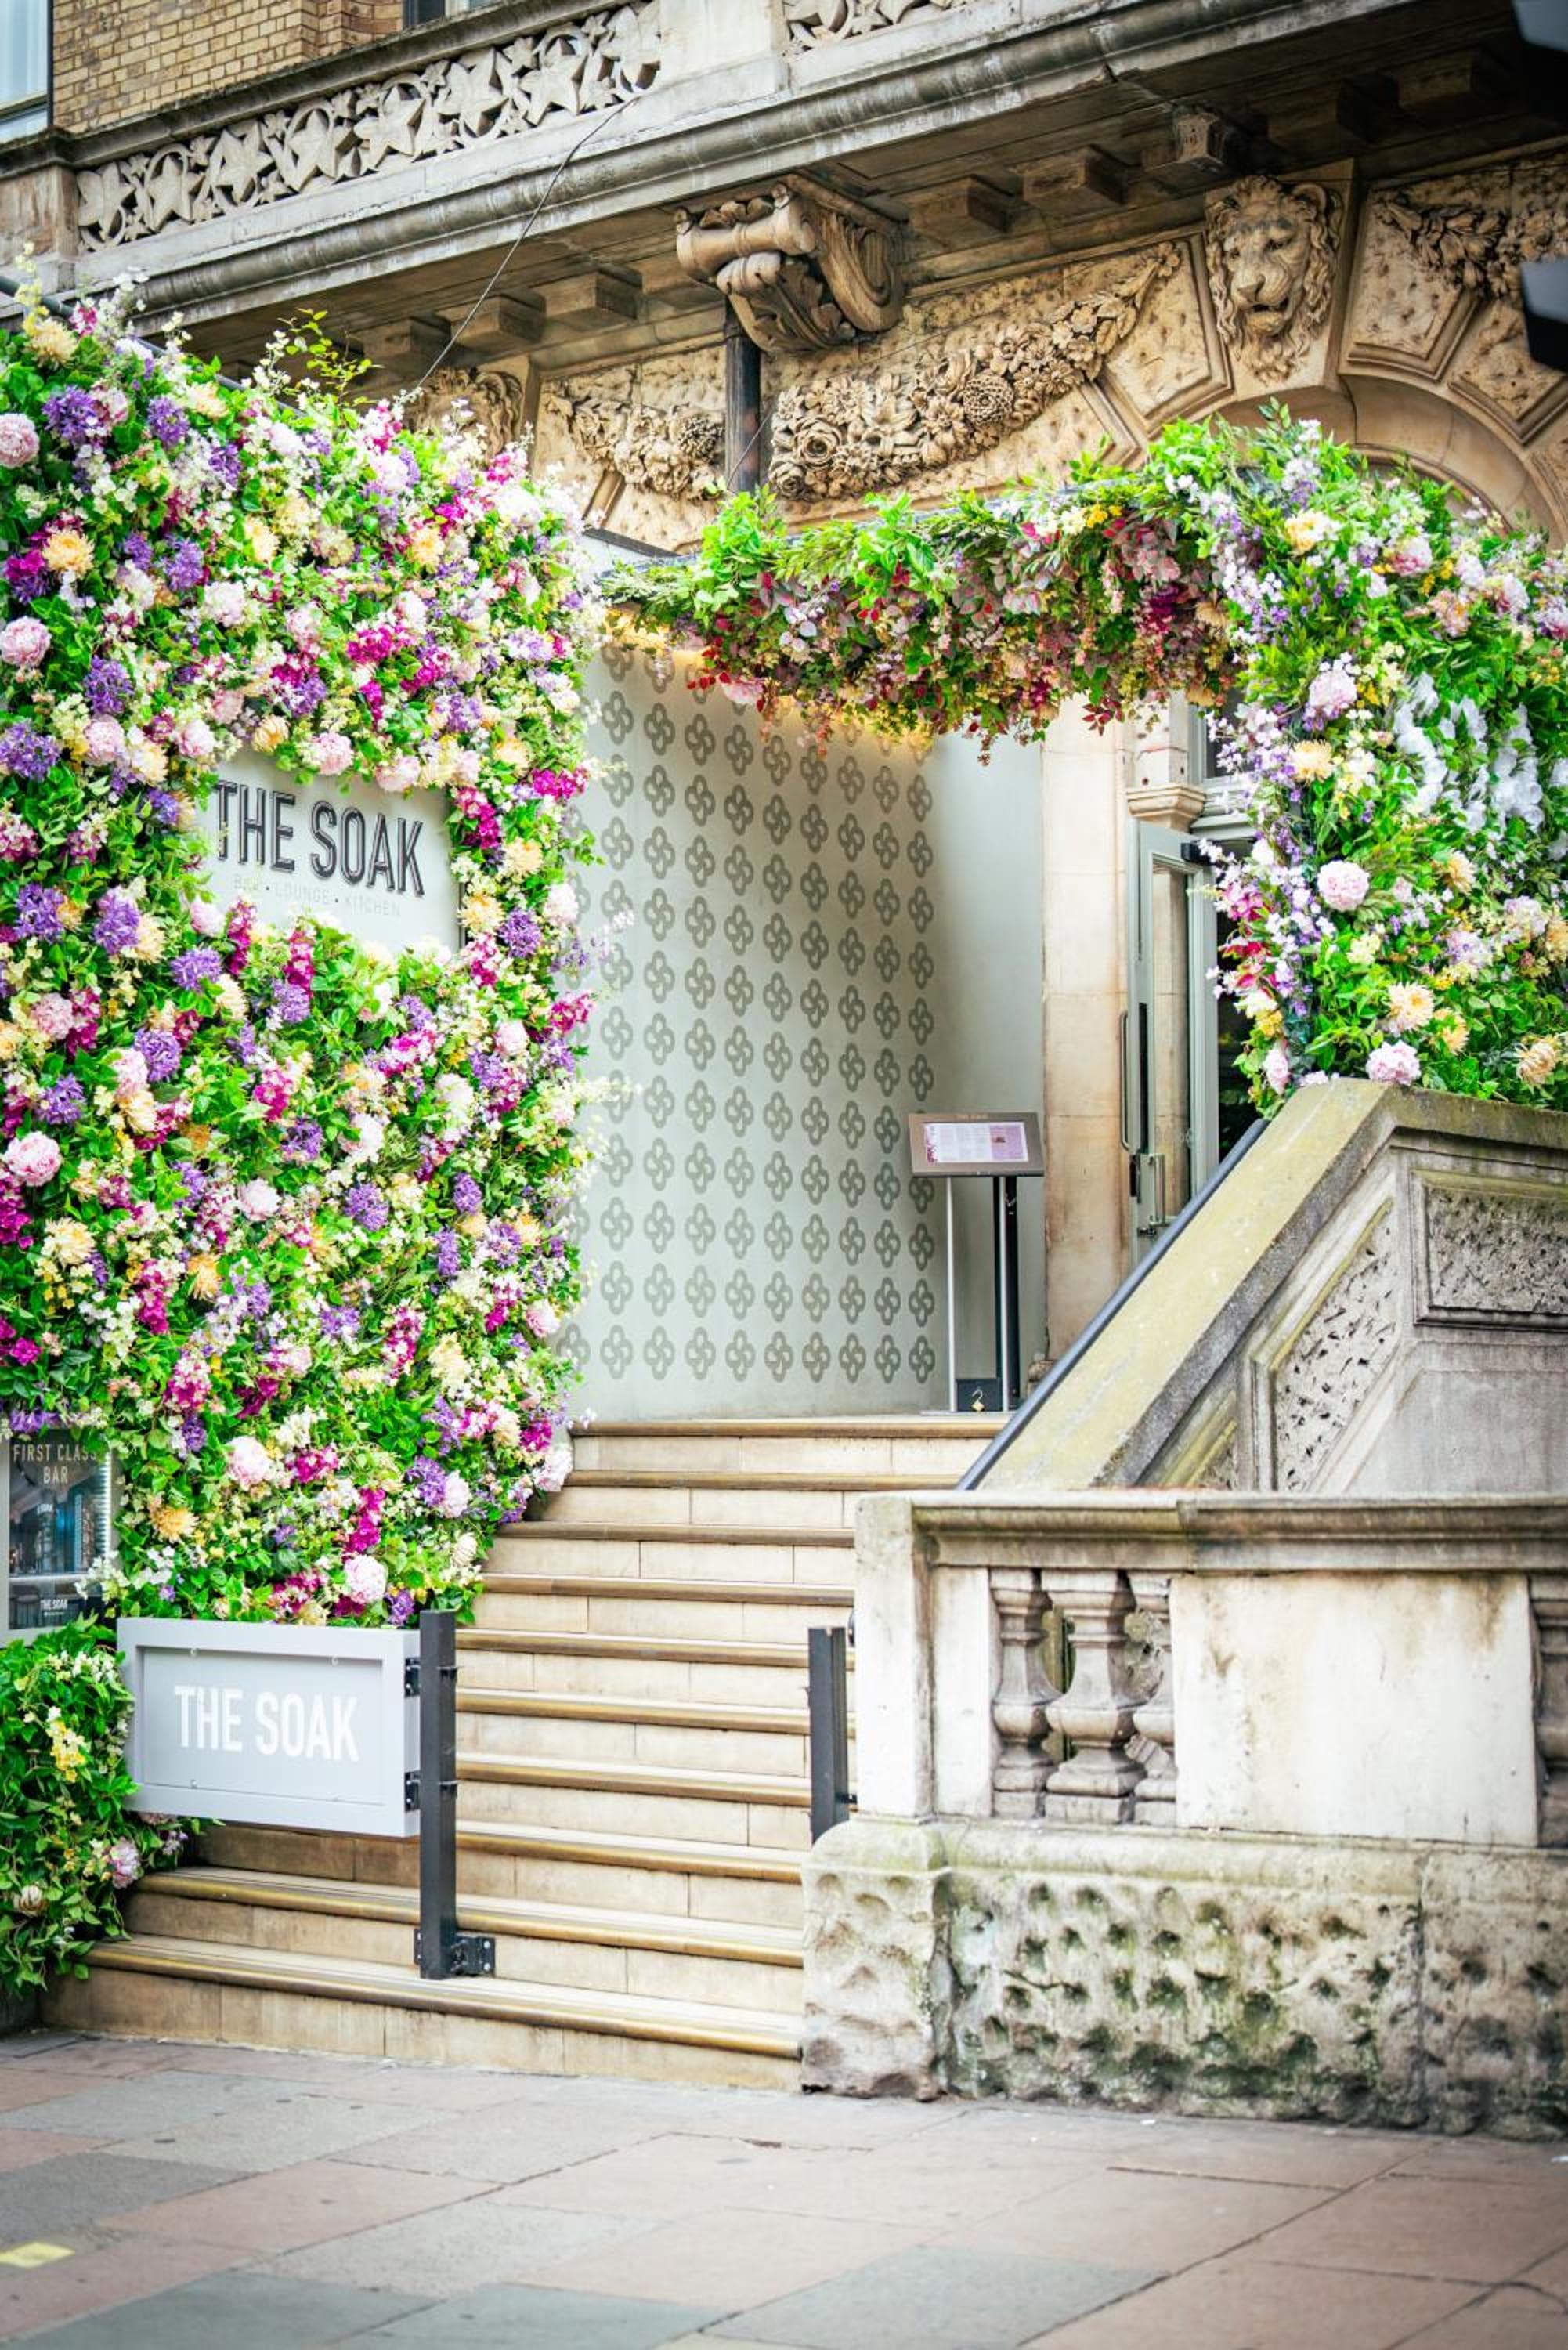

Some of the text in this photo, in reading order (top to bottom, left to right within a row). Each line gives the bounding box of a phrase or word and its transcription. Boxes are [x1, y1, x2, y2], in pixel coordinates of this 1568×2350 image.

[215, 780, 425, 898] THE SOAK
[13, 1444, 51, 1462] FIRST
[43, 1466, 68, 1484] BAR
[175, 1685, 359, 1762] THE SOAK
